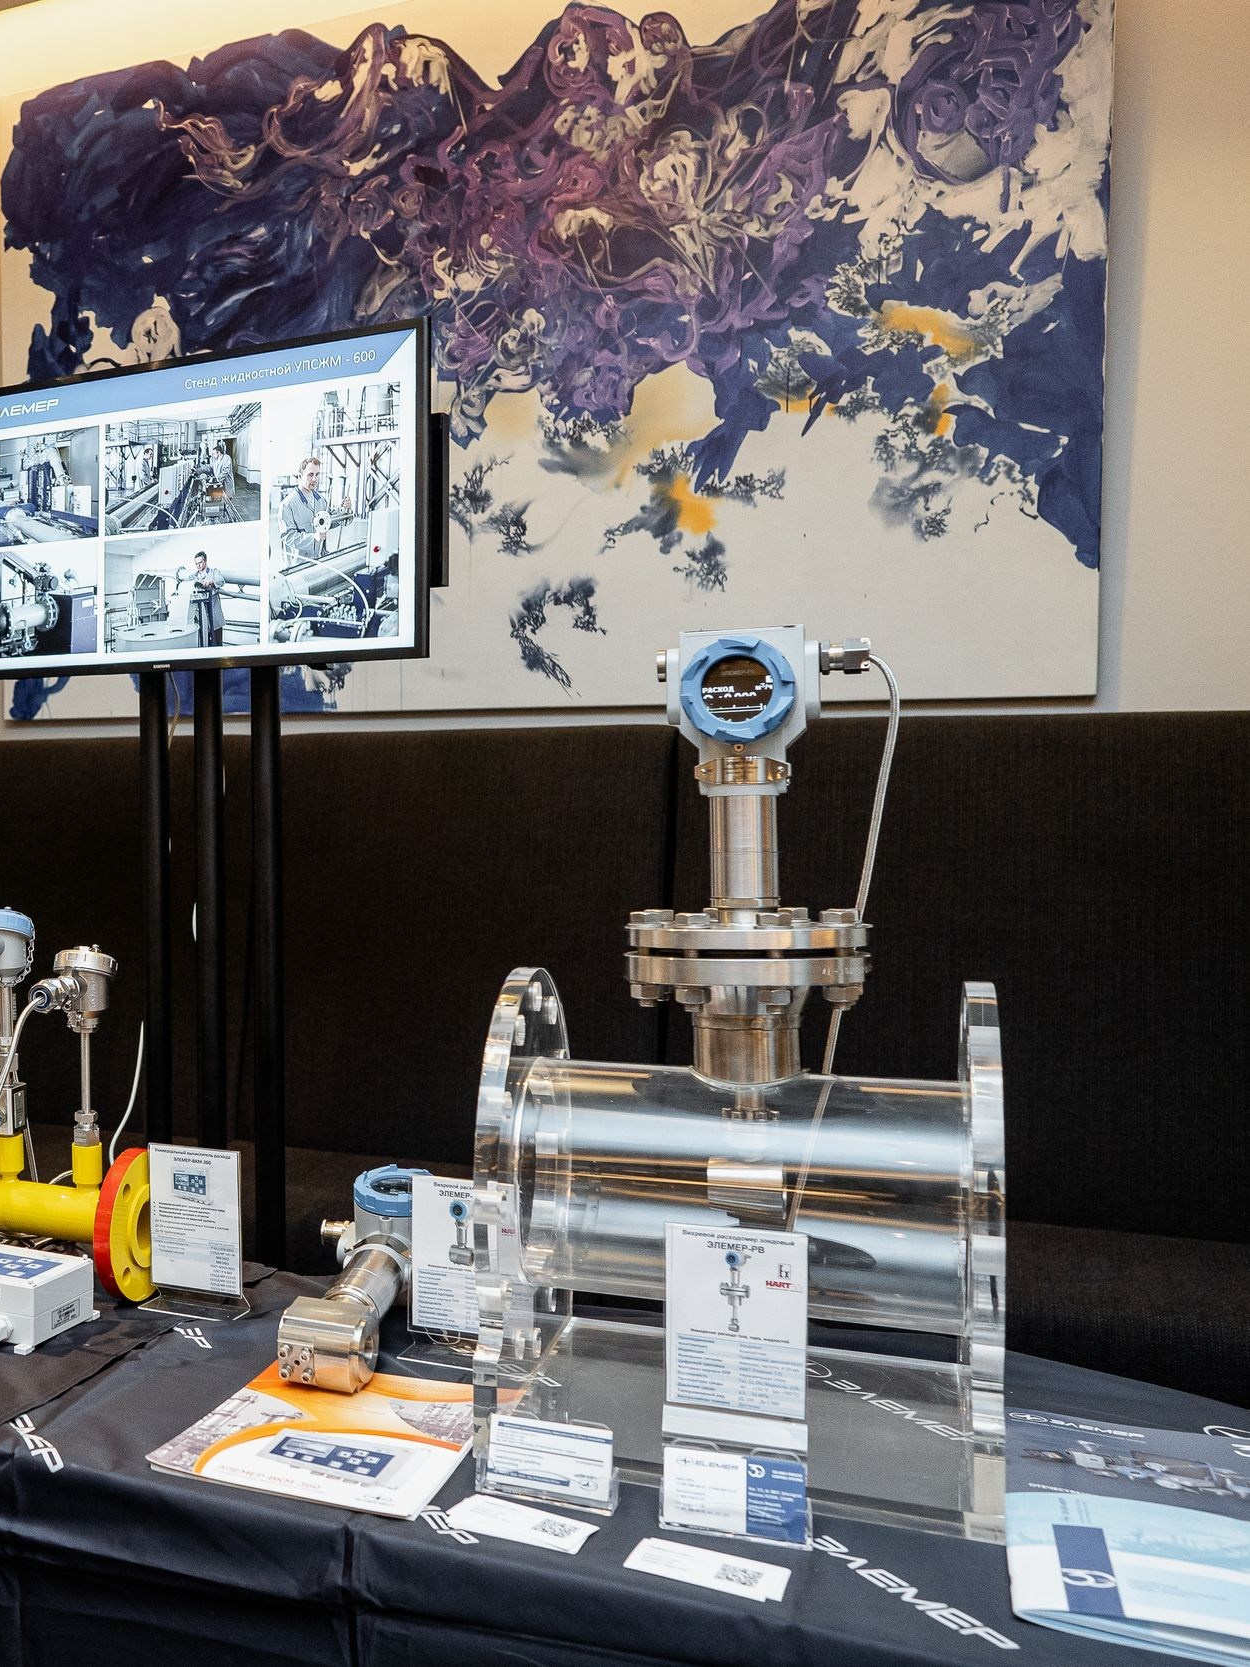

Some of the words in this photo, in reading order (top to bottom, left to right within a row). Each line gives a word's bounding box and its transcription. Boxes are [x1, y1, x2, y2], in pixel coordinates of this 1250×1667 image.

[184, 377, 218, 389] Стенд
[220, 364, 291, 384] жидкостной
[293, 354, 342, 373] УПСЖМ
[353, 349, 377, 364] 600
[433, 1181, 459, 1190] Вихревой
[682, 1229, 715, 1238] Вихревой
[716, 1234, 758, 1243] расходомер
[707, 1240, 765, 1254] ЭЛЕМЕР-РВ
[765, 1280, 792, 1289] HART
[812, 1535, 1021, 1650] ЭЛЕМЕР
